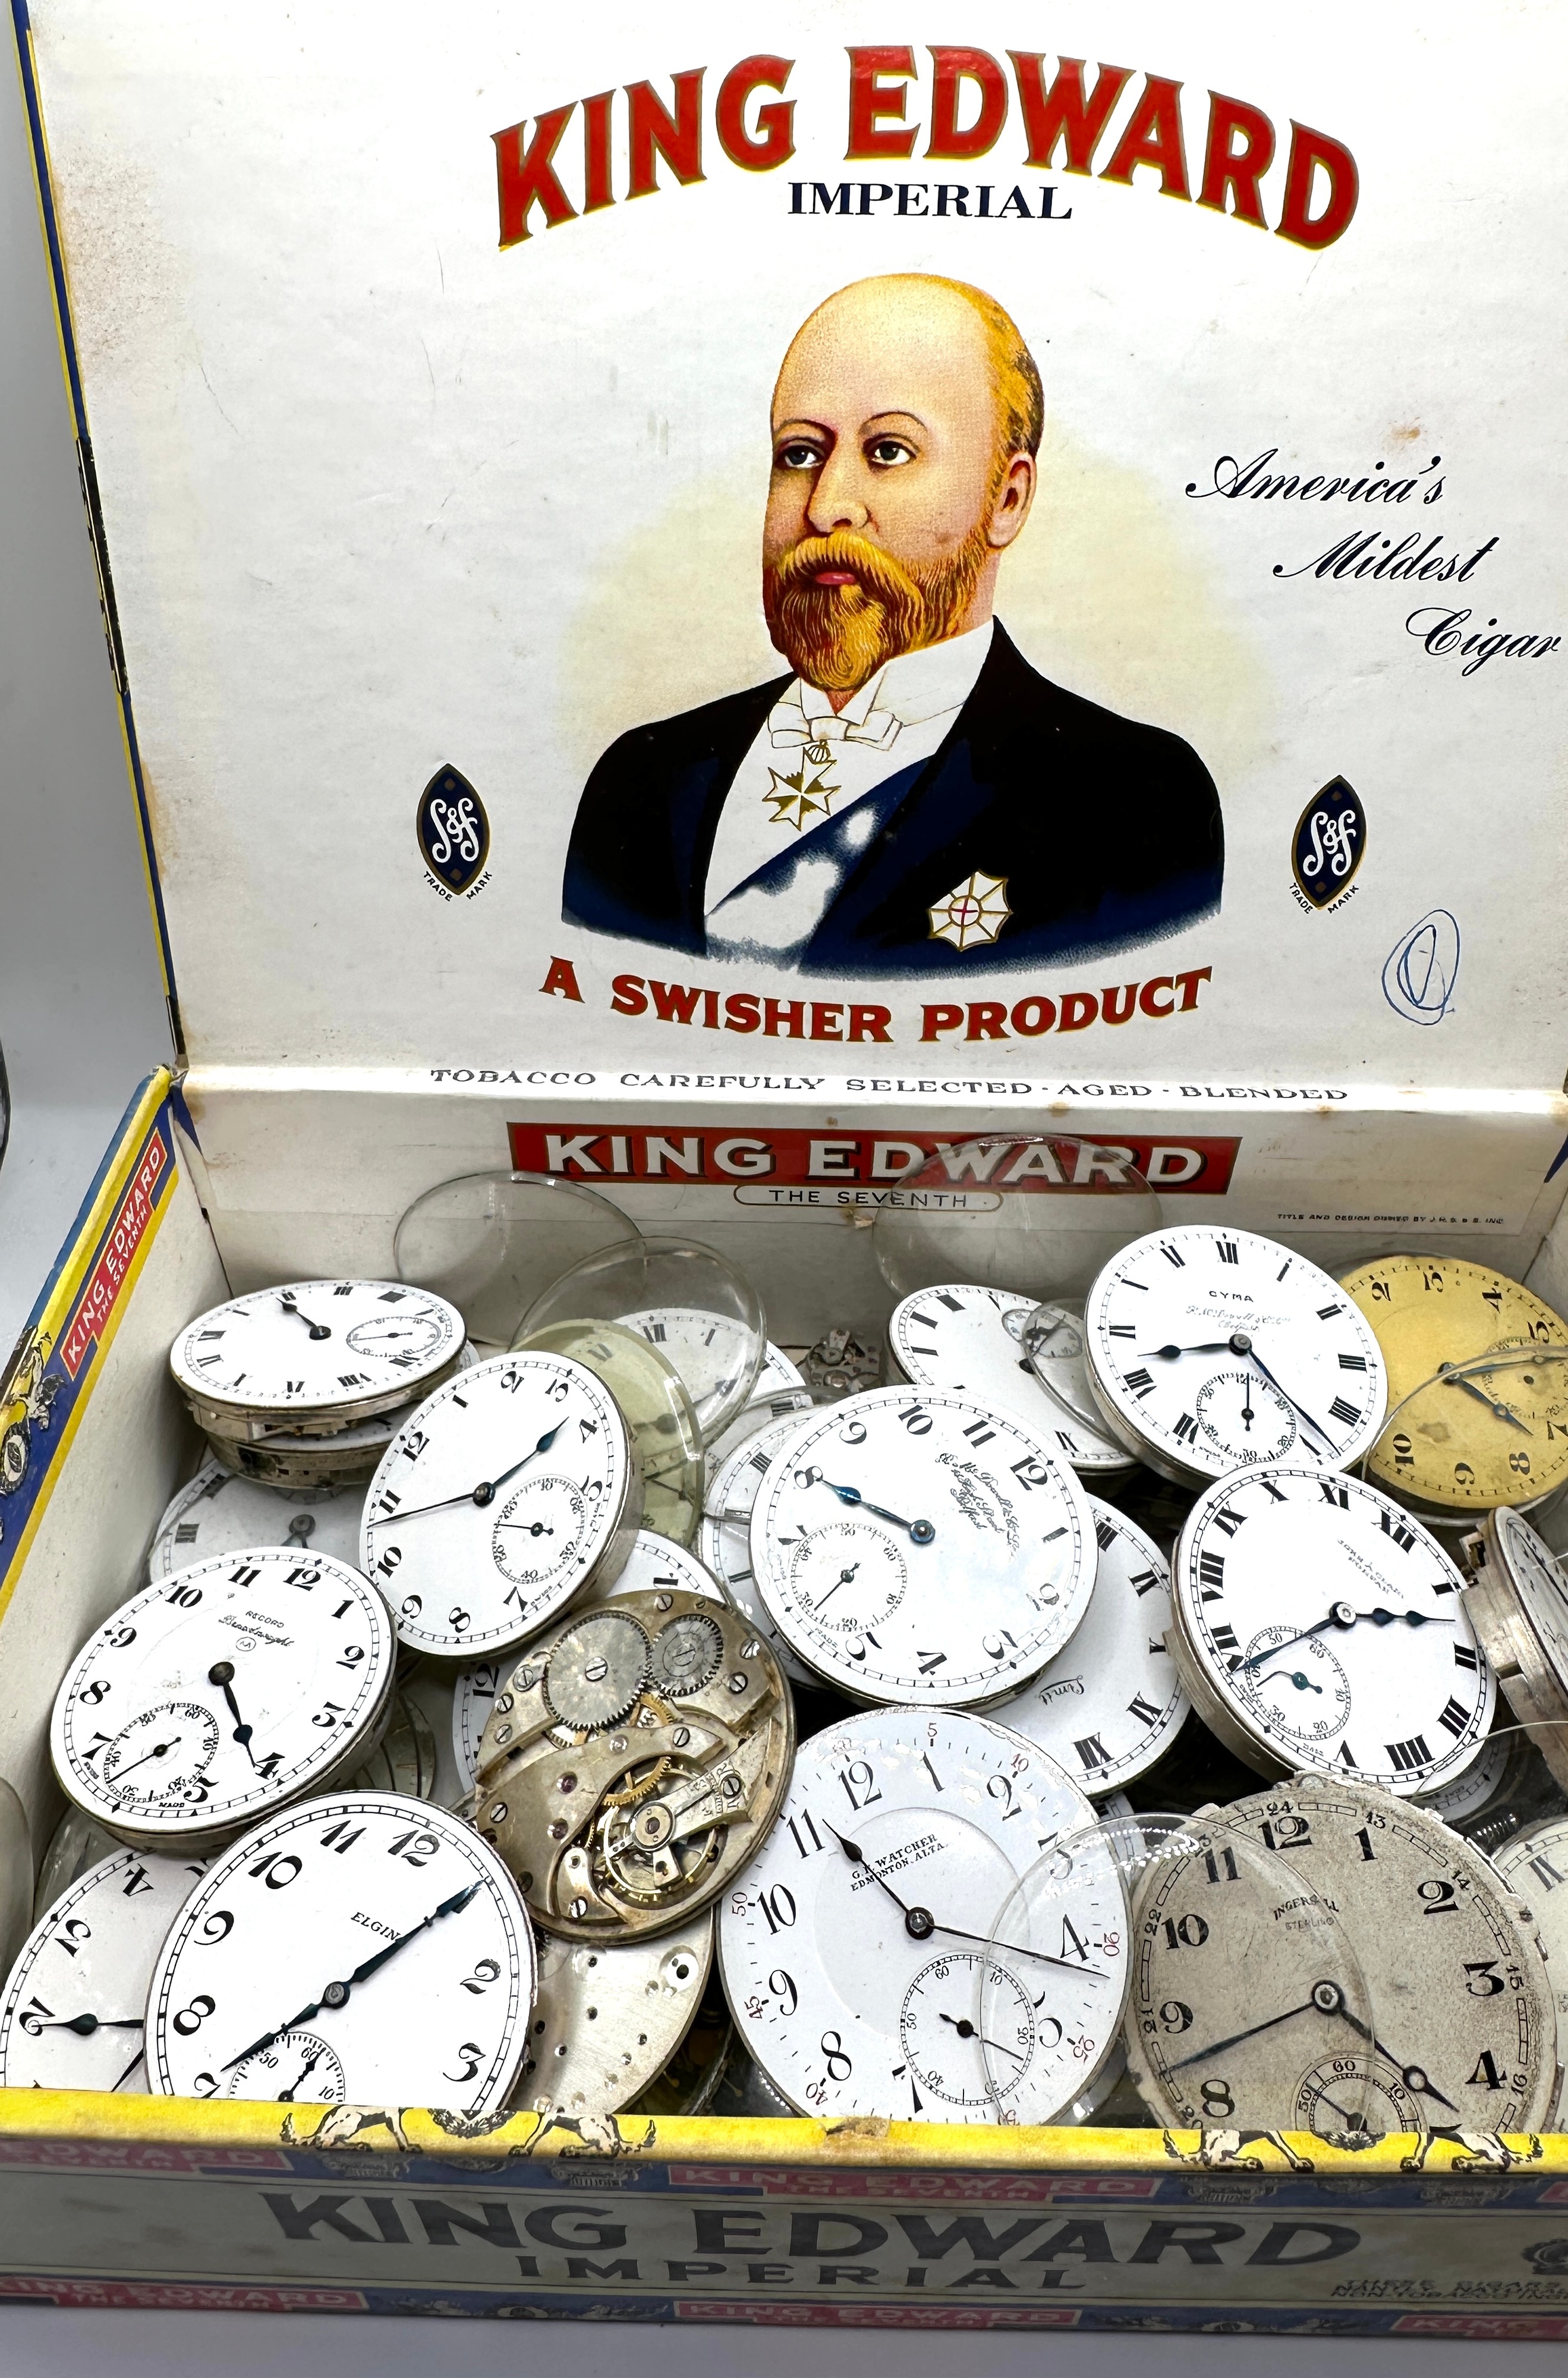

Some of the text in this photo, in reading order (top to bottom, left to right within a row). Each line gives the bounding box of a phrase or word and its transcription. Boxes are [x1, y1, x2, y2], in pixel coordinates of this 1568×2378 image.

[490, 45, 1360, 252] KING EDWARD
[788, 181, 1073, 221] IMPERIAL
[1185, 448, 1446, 504] America's
[1273, 530, 1500, 581] Mildest
[1406, 608, 1561, 677] Cigar
[423, 871, 492, 901] TRADE MARK
[1289, 882, 1359, 914] TRADE MARK
[539, 955, 1213, 1043] A SWISHER PRODUCT
[430, 1070, 1348, 1101] TOBACCO CAREFULLY SELECTED AGED BLENDED
[544, 1134, 1206, 1187] KING EDWARD
[770, 1190, 968, 1208] THE SEVENTH
[68, 1147, 159, 1364] KING EDWARD
[97, 1205, 148, 1322] THE SEVENTH
[1209, 1291, 1254, 1302] CYMA
[1371, 1282, 1391, 1301] 2
[1482, 1287, 1503, 1313] 4
[1527, 1321, 1549, 1343] 5
[501, 1371, 524, 1394] 2
[546, 1379, 569, 1402] 3
[452, 1395, 468, 1408] 1
[580, 1418, 599, 1443] 4
[839, 1421, 867, 1445] 9
[898, 1405, 933, 1435] 10
[963, 1420, 996, 1449] 11
[403, 1432, 430, 1461] 12
[1393, 1433, 1415, 1466] 10
[794, 1466, 823, 1489] 8
[1009, 1455, 1047, 1491] 12
[1454, 1462, 1475, 1484] 9
[1509, 1452, 1530, 1475] 8
[380, 1490, 402, 1514] 11
[584, 1476, 603, 1501] 5
[1259, 1480, 1289, 1503] X
[1212, 1502, 1248, 1539] IX
[1371, 1509, 1418, 1555] XII
[228, 1566, 262, 1587] 11
[377, 1546, 402, 1578] 10
[283, 1568, 321, 1591] 12
[164, 1585, 203, 1608] 10
[332, 1600, 354, 1619] 1
[401, 1594, 422, 1619] 9
[503, 1586, 528, 1612] 7
[245, 1611, 284, 1628] RECORD
[449, 1607, 471, 1632] 8
[110, 1627, 137, 1648] 9
[845, 1631, 883, 1661] 5
[336, 1646, 365, 1670] 2
[917, 1650, 947, 1675] 4
[80, 1680, 112, 1704] 8
[311, 1701, 346, 1728] 3
[1437, 1695, 1472, 1739] III
[927, 1723, 937, 1737] 5
[82, 1732, 114, 1760] 7
[1334, 1740, 1359, 1768] V
[1384, 1735, 1435, 1770] IIII
[253, 1753, 285, 1780] 4
[922, 1751, 946, 1793] 1
[1011, 1753, 1029, 1772] 10
[183, 1777, 219, 1803] 5
[837, 1761, 883, 1810] 12
[986, 1775, 1022, 1821] 2
[1266, 1801, 1293, 1816] 24
[1365, 1811, 1387, 1829] 13
[320, 1820, 367, 1854] 11
[786, 1808, 826, 1859] 11
[1258, 1816, 1312, 1850] 12
[1354, 1827, 1378, 1862] 1
[388, 1830, 440, 1867] 12
[875, 1834, 937, 1867] WATCHER
[248, 1851, 303, 1889] 10
[1201, 1844, 1243, 1885] 11
[122, 1863, 154, 1896] 4
[1451, 1870, 1471, 1891] 14
[731, 1892, 748, 1916] 50
[757, 1885, 796, 1935] 10
[1418, 1880, 1459, 1915] 2
[55, 1919, 91, 1957] 3
[194, 1910, 234, 1945] 9
[351, 1911, 401, 1943] ELGIN
[1060, 1914, 1090, 1961] 4
[1161, 1914, 1209, 1950] 10
[459, 1959, 501, 1994] 2
[934, 1965, 949, 1980] 60
[990, 1971, 1003, 1985] 10
[1462, 1961, 1505, 1996] 3
[1507, 1966, 1524, 1990] 15
[769, 1970, 798, 2015] 9
[19, 1996, 56, 2036] 2
[173, 1995, 216, 2036] 8
[744, 1996, 764, 2019] 45
[907, 2013, 917, 2030] 50
[1159, 2001, 1194, 2034] 9
[260, 2052, 279, 2068] 50
[442, 2043, 486, 2082] 3
[821, 2031, 852, 2081] 8
[1332, 2059, 1356, 2072] 60
[1465, 2050, 1507, 2090] 4
[928, 2070, 944, 2086] 40
[1389, 2082, 1405, 2100] 10
[1512, 2074, 1528, 2097] 16
[318, 2087, 335, 2100] 10
[1200, 2080, 1235, 2118] 8
[1298, 2089, 1312, 2112] 50
[685, 2169, 1138, 2193] KING EDWARD
[259, 2193, 1362, 2266] KING EDWARD
[517, 2255, 1088, 2290] IMPERIAL
